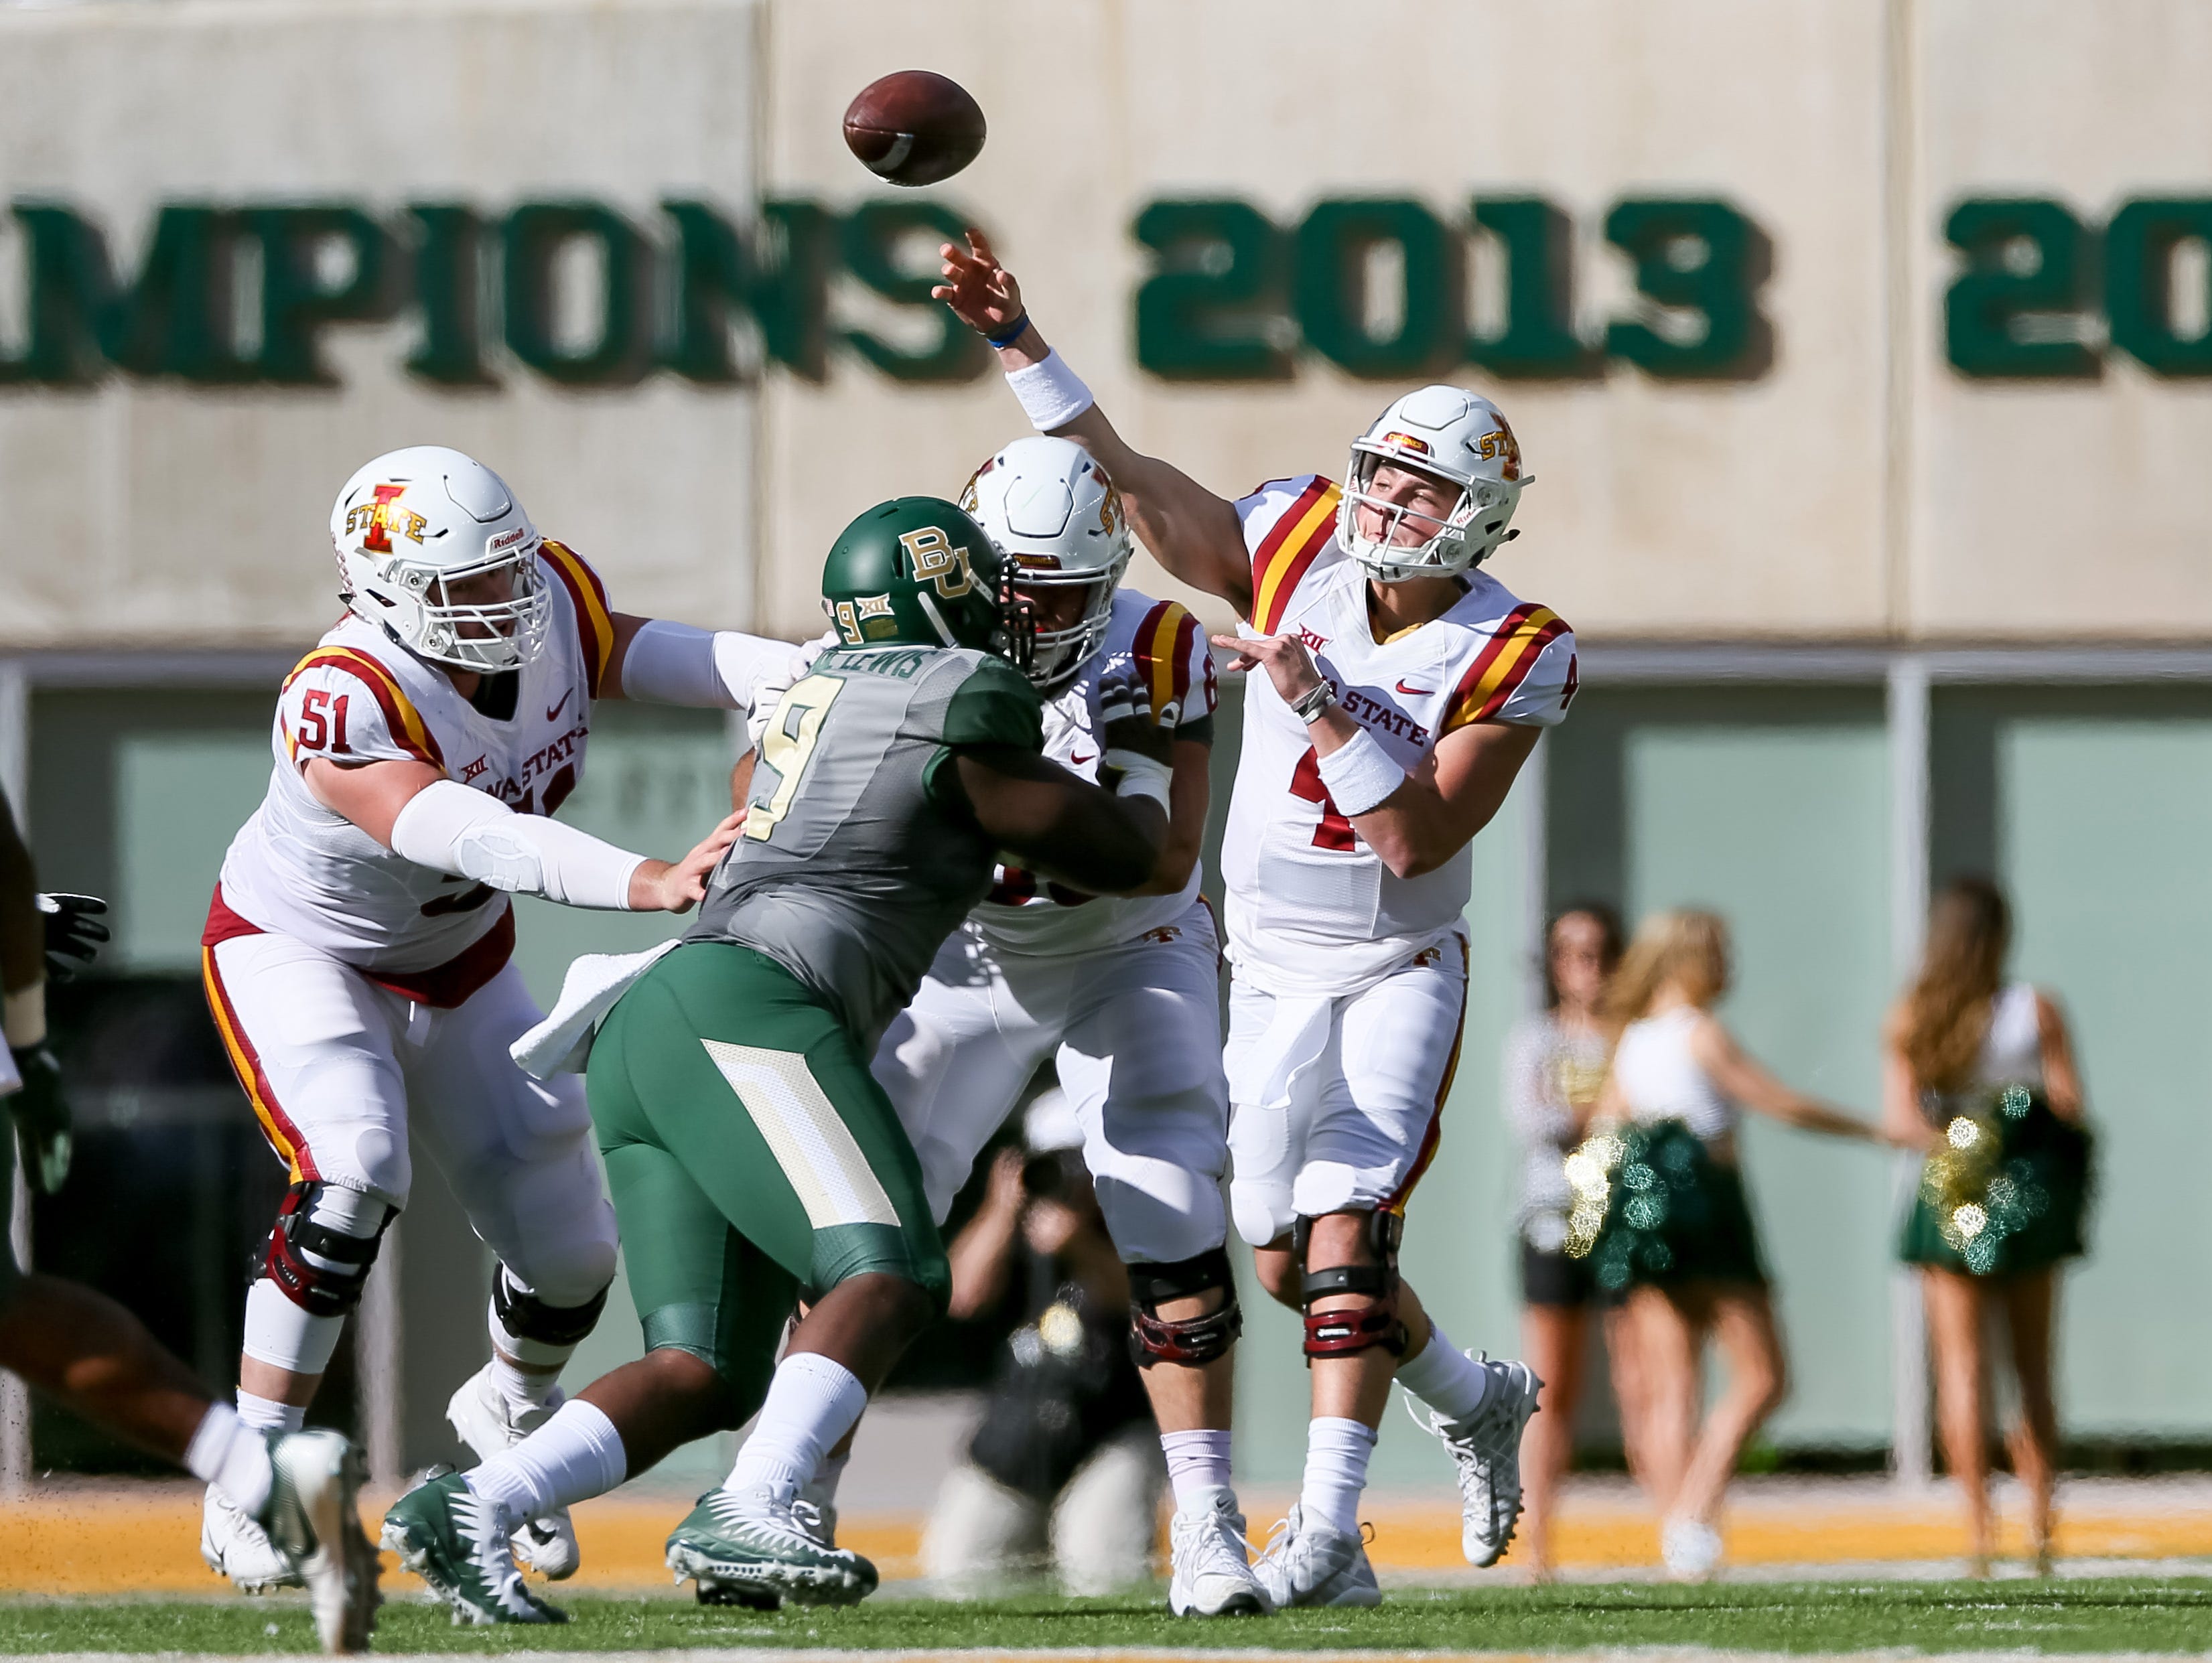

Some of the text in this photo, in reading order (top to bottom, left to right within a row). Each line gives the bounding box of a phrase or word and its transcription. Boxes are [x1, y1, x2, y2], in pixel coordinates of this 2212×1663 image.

[0, 201, 988, 382] MPIONS
[1133, 199, 1769, 382] 2013
[345, 502, 427, 545] STATE
[898, 526, 974, 599] BU
[837, 601, 864, 644] 9
[840, 650, 939, 679] LEWIS
[1560, 653, 1580, 711] 4
[299, 689, 352, 753] 51
[1341, 691, 1430, 747] STATE
[744, 672, 847, 843] 9
